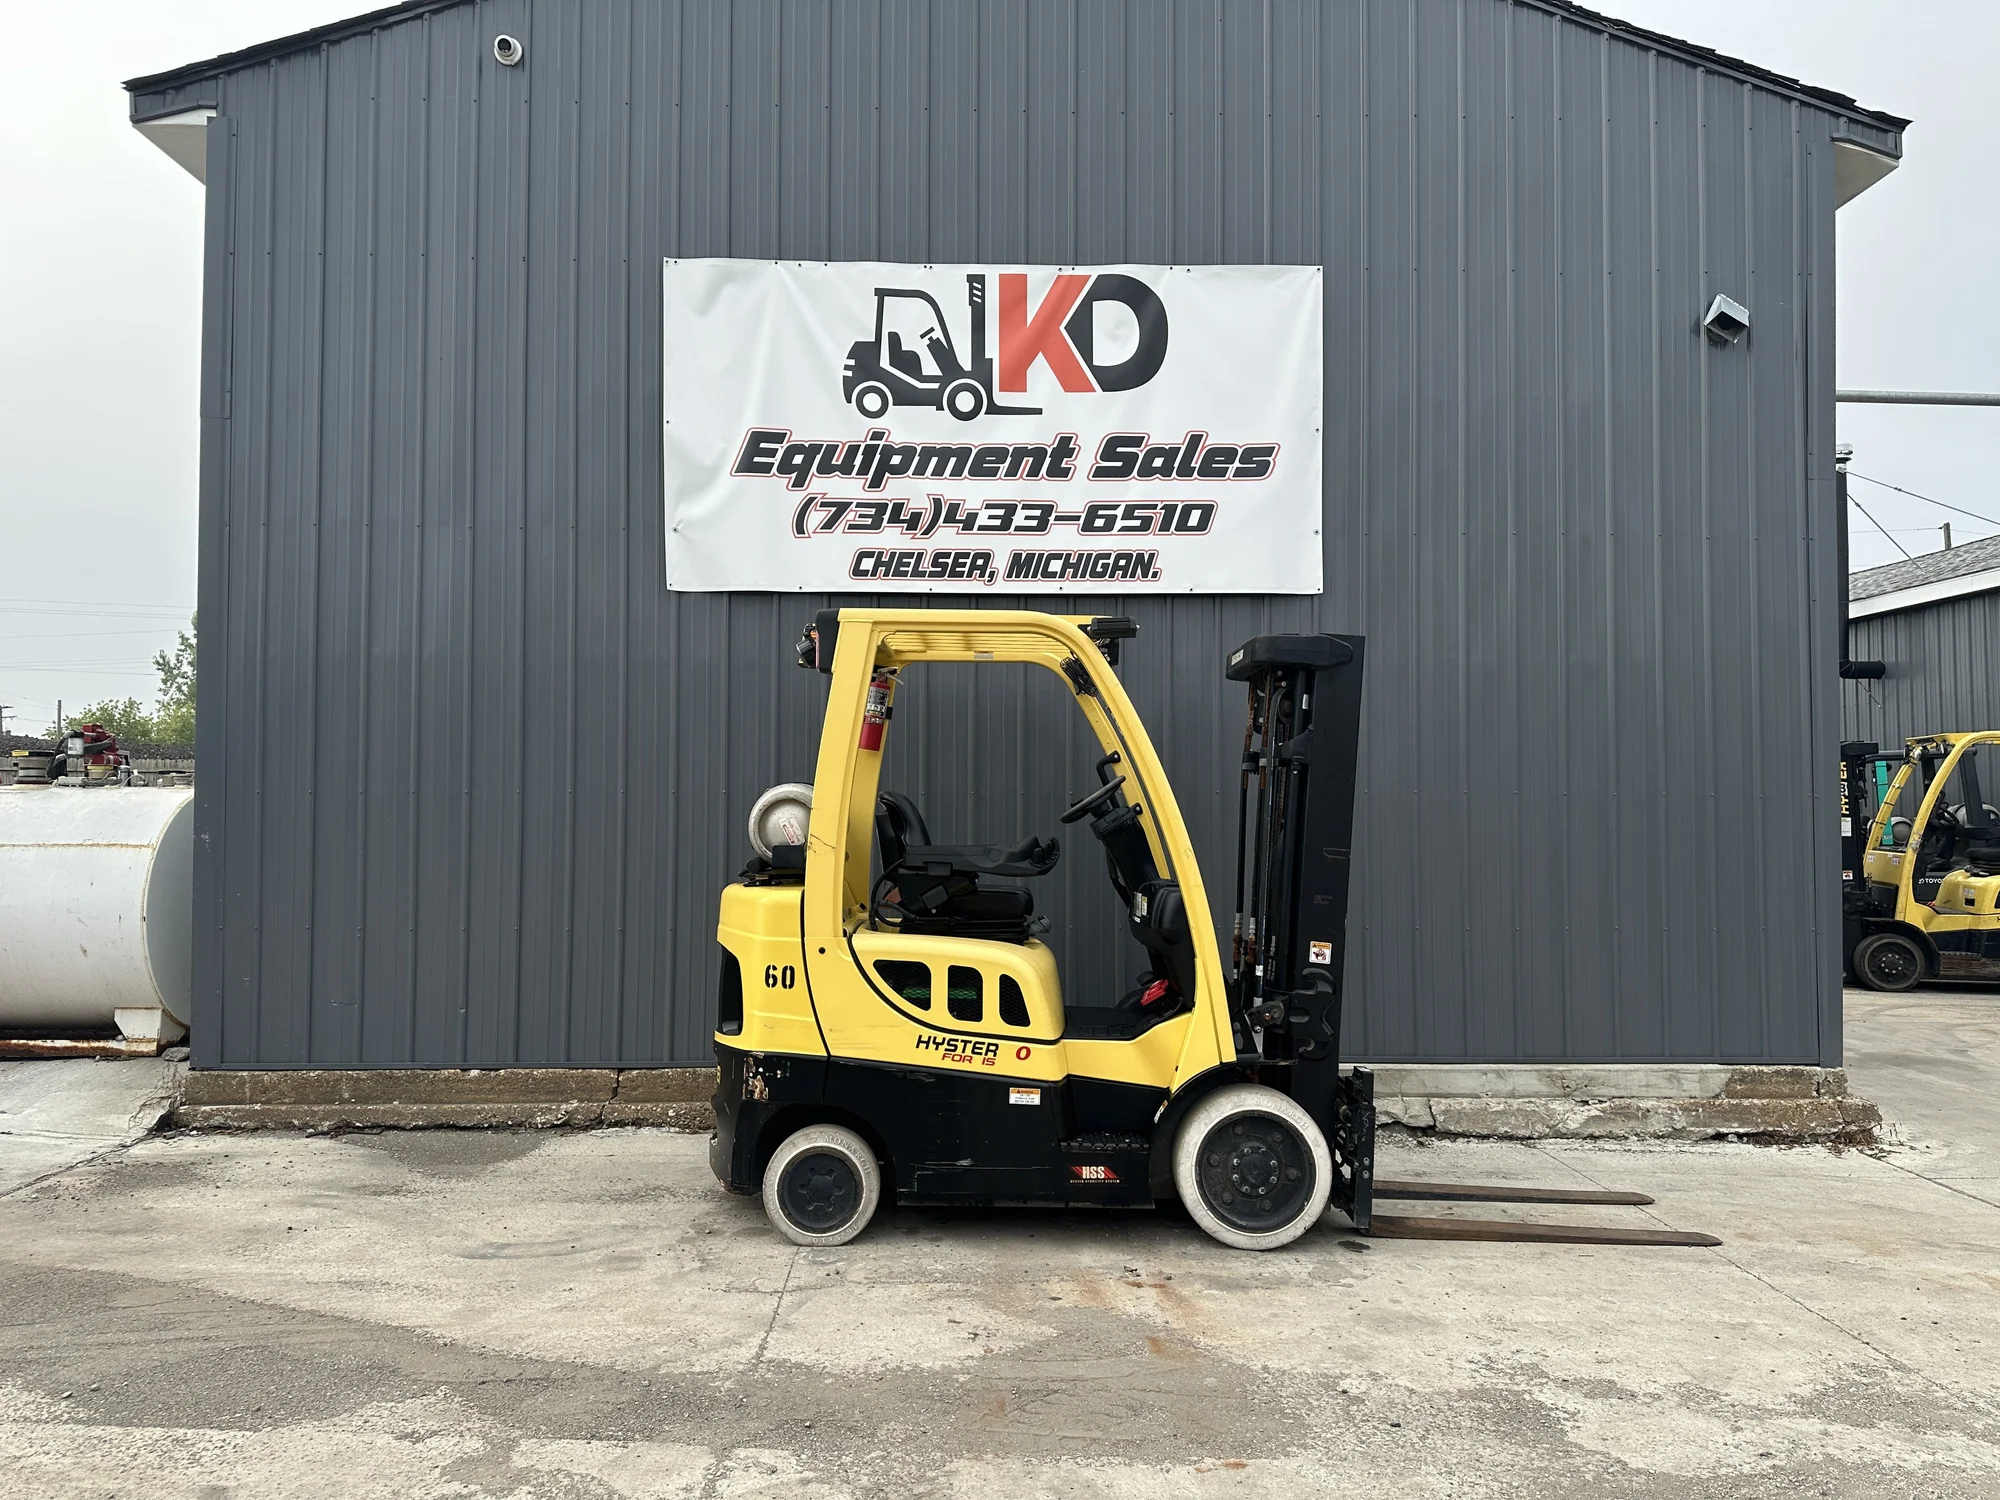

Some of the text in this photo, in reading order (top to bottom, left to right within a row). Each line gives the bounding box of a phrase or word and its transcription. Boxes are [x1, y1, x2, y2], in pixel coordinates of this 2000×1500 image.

[998, 273, 1169, 393] KD
[732, 429, 1279, 490] Equipment Sales
[793, 494, 1217, 538] (734)433-6510
[850, 549, 1161, 584] CHELSEA, MICHIGAN.
[765, 964, 795, 989] 60
[915, 1034, 1000, 1057] HYSTER
[1255, 1098, 1310, 1130] MONARCH
[823, 1134, 872, 1174] MONARCH
[1082, 1166, 1105, 1179] HSS
